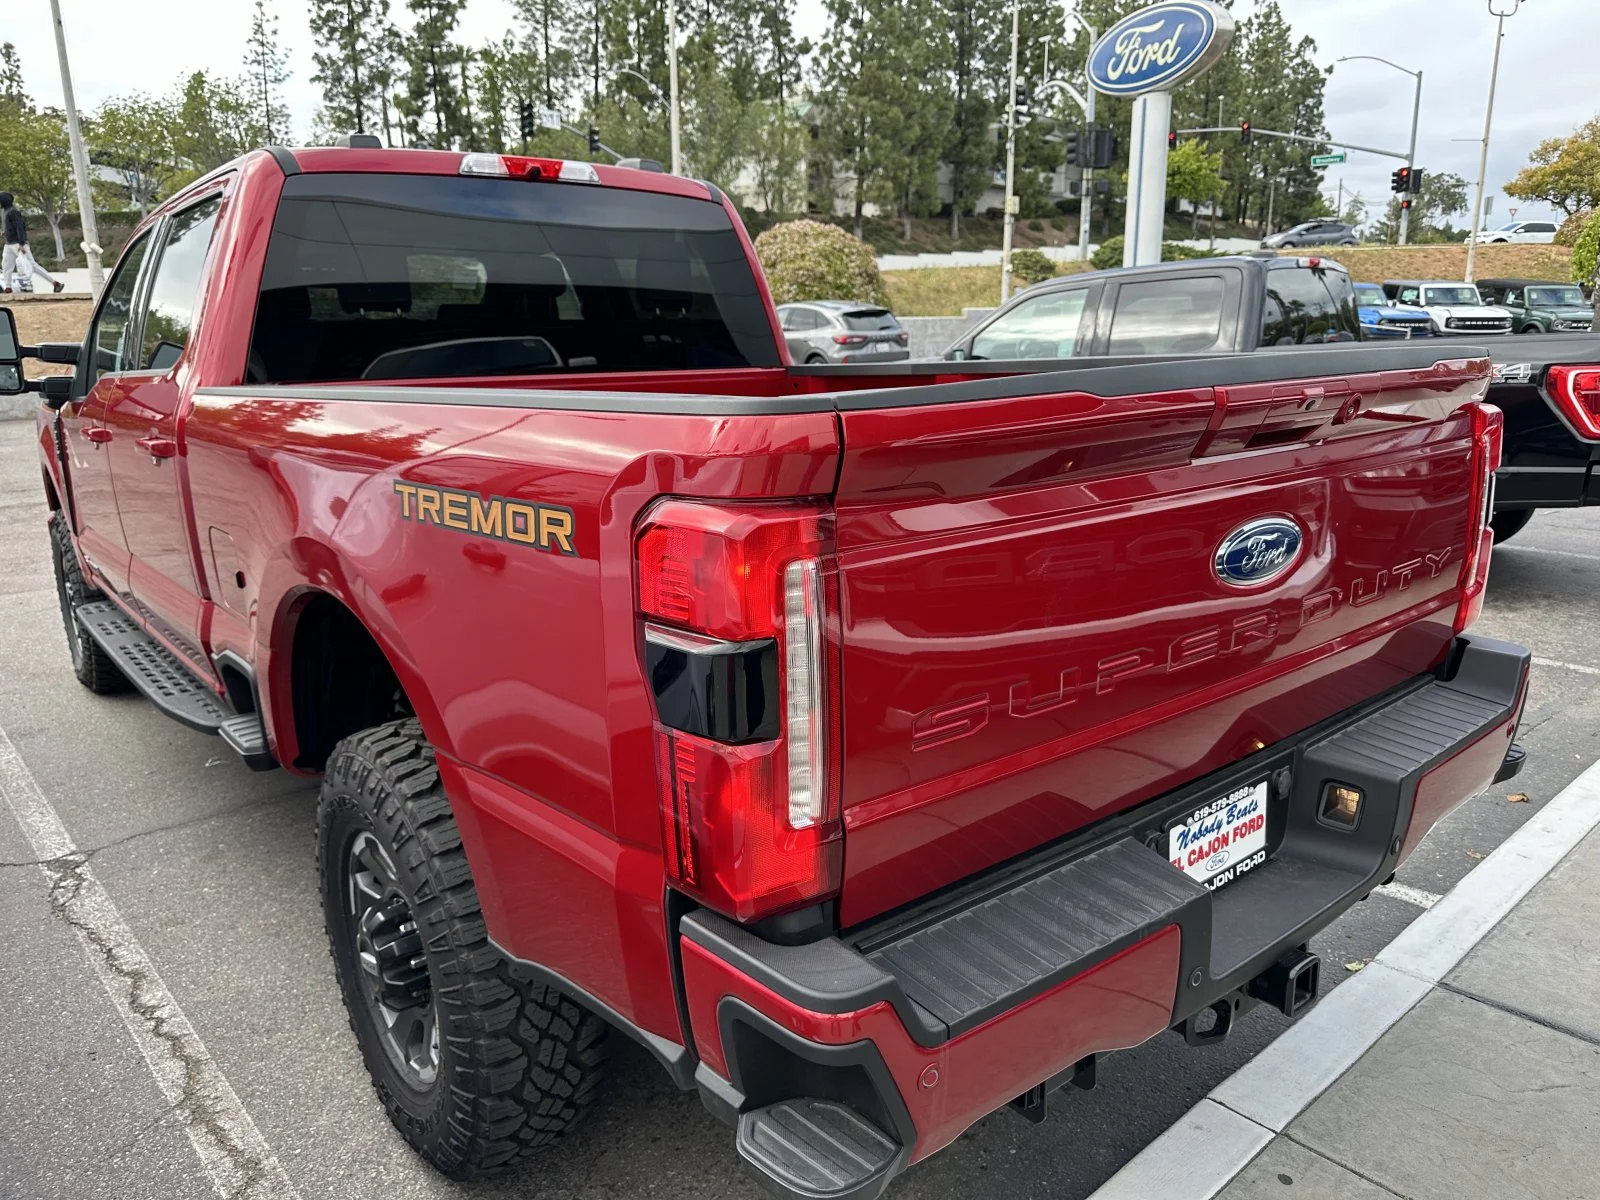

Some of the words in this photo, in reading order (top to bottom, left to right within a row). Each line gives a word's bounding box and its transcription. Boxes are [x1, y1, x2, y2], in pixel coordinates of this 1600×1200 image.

[1107, 19, 1184, 81] Ford
[394, 480, 577, 556] TREMOR
[1241, 532, 1289, 573] Ford
[911, 607, 1279, 752] SUPER
[1300, 546, 1452, 626] DUTY
[1176, 814, 1223, 850] Nobody
[1226, 799, 1258, 826] Beats
[1187, 831, 1230, 867] CAJON
[1232, 814, 1264, 843] FORD
[1236, 850, 1266, 876] FORD
